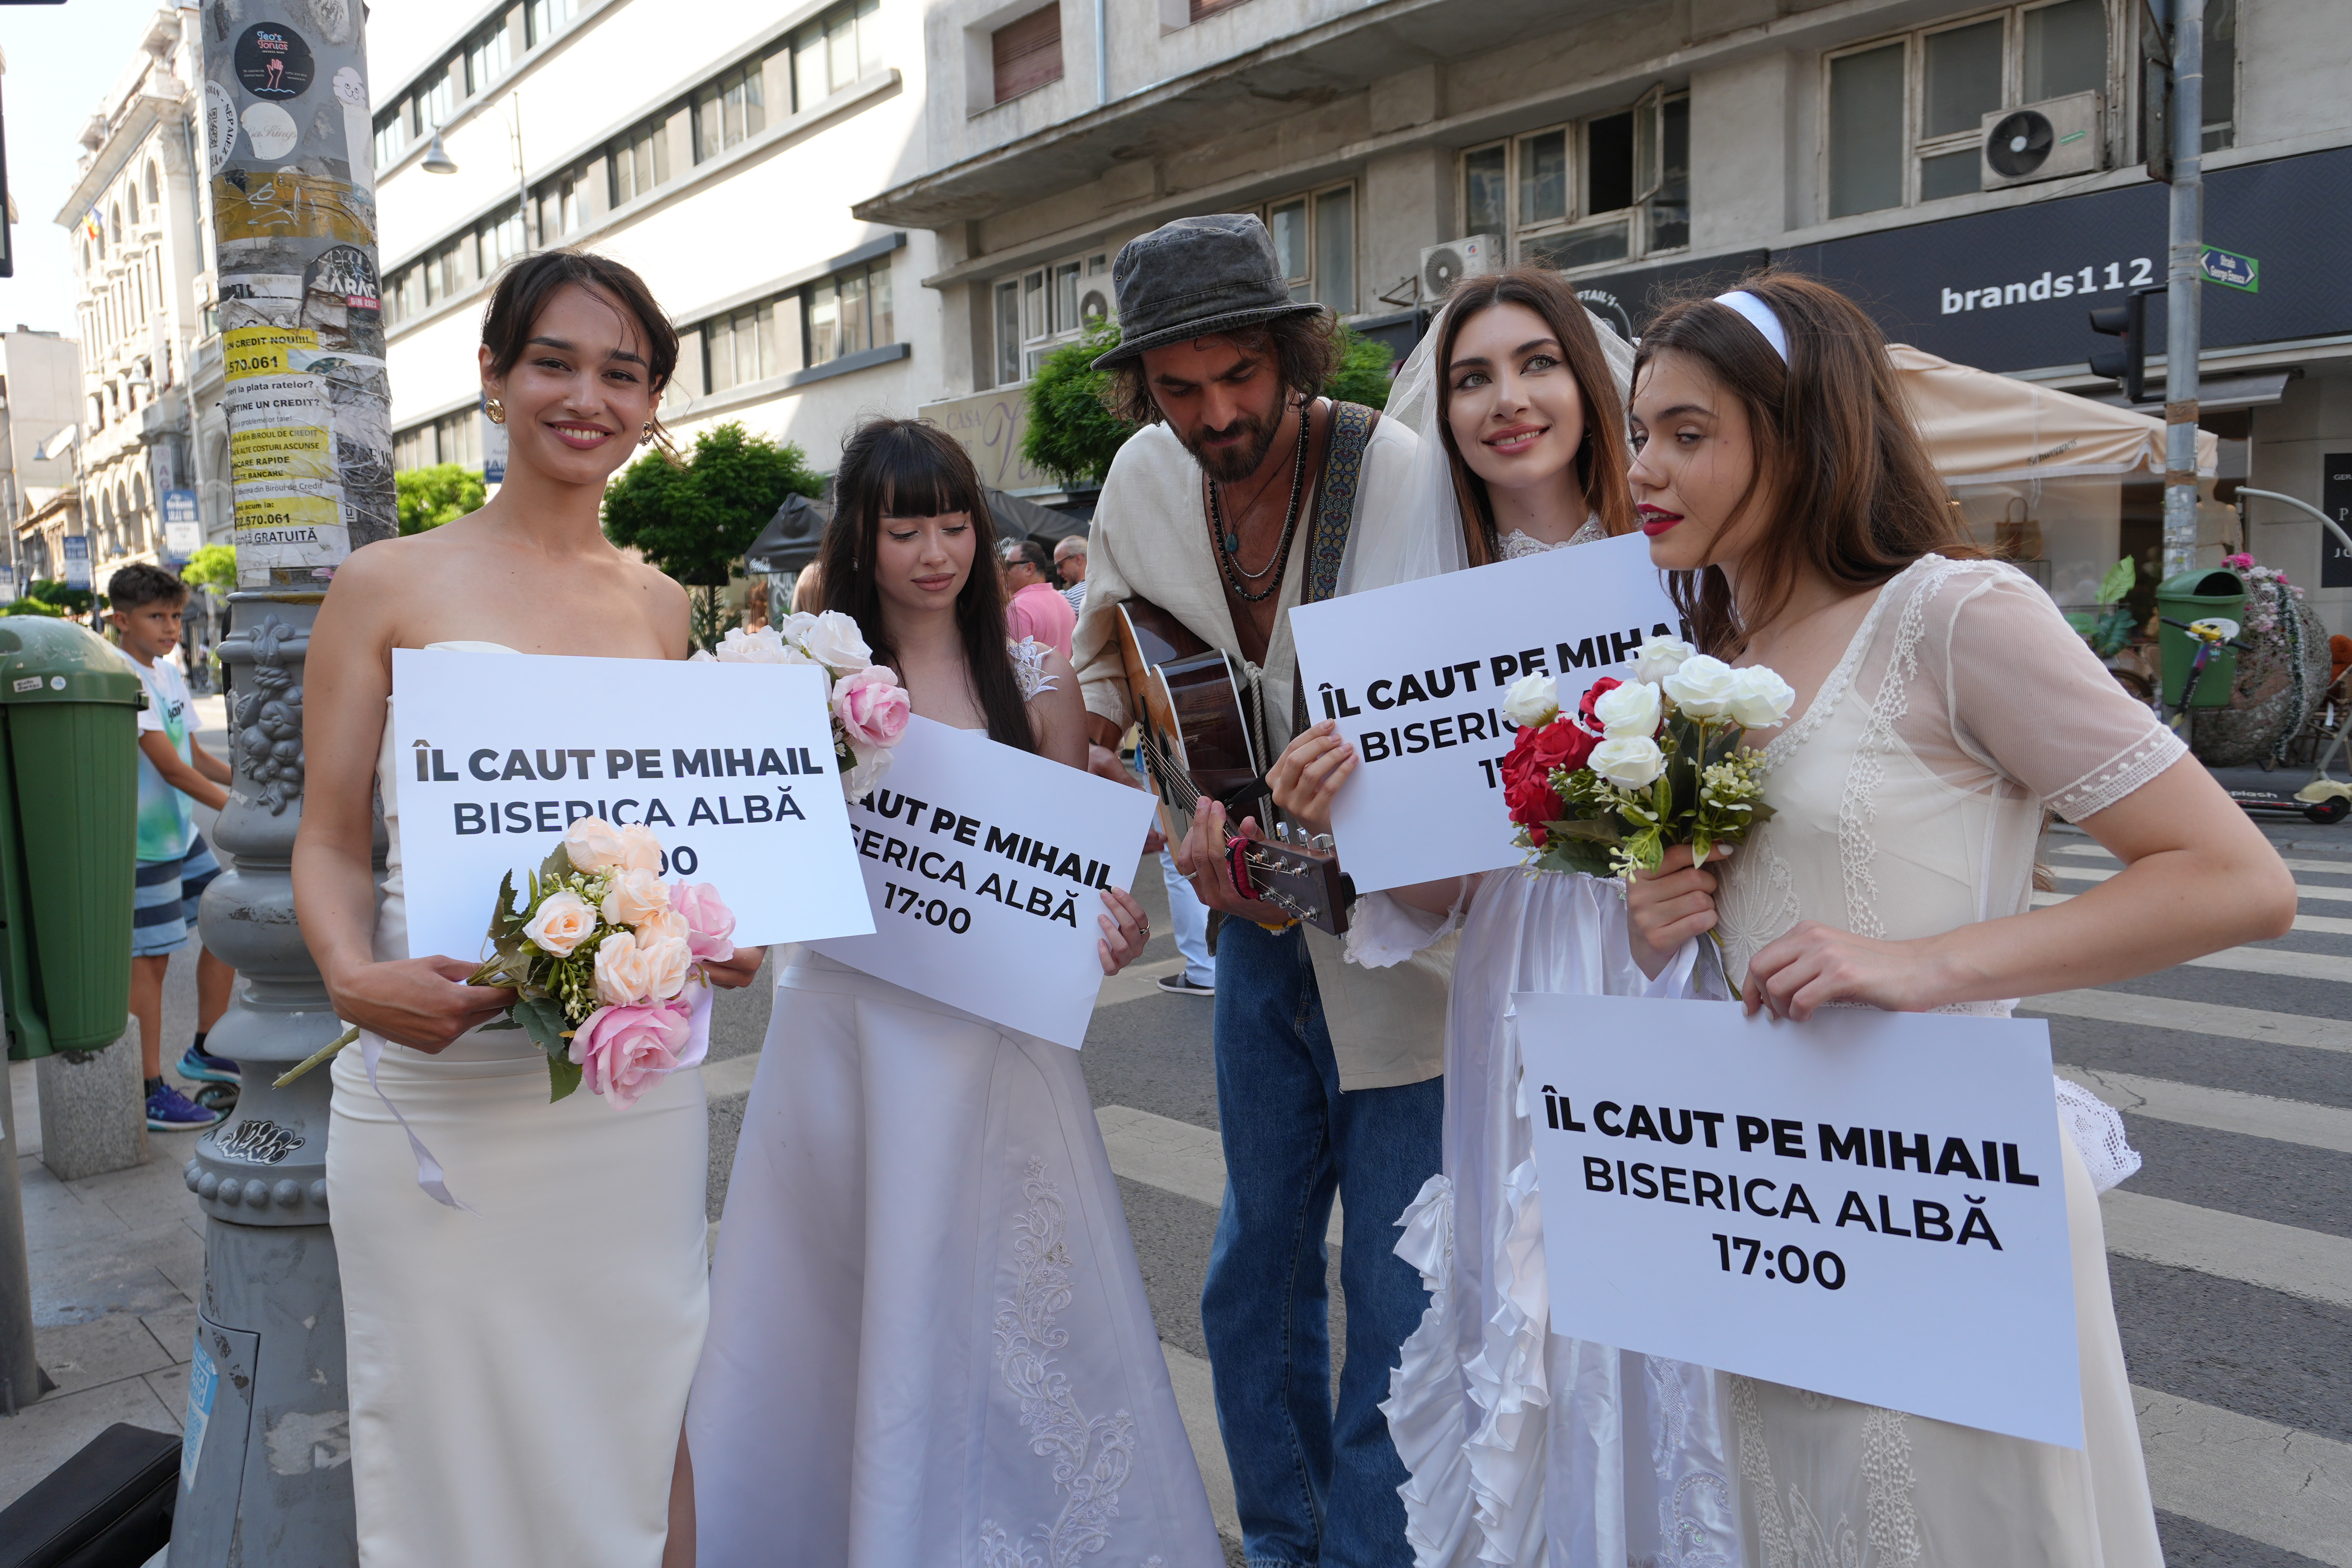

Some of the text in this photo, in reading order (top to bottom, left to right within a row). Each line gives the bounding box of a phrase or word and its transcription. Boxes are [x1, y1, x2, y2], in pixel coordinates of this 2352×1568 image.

[257, 31, 282, 41] Teo's
[258, 40, 288, 51] Tonics
[223, 104, 234, 156] NEPALEZ
[1941, 257, 2153, 315] brands112
[236, 337, 267, 347] CREDIT
[238, 385, 244, 394] la
[247, 383, 269, 393] plata
[272, 381, 313, 389] ratelor?
[273, 399, 320, 407] CREDIT?
[241, 416, 275, 427] problemelor
[946, 409, 981, 431] CASA
[251, 431, 275, 440] BIROUL
[253, 444, 281, 452] COSTURI
[256, 457, 290, 465] RAPIDE
[248, 470, 284, 479] BANCARE
[254, 527, 318, 544] GRATUITĂ
[1317, 683, 1361, 721] ÎL
[1367, 660, 1481, 710] CAUT
[1490, 647, 1550, 686] PE
[411, 739, 824, 782] ÎL CAUT PE MIHAIL
[687, 786, 806, 827] ALBĂ
[847, 788, 1115, 895] AUT PE MIHAIL
[884, 881, 971, 934] 17:00
[975, 872, 1079, 928] ALBĂ
[1541, 1084, 2040, 1187] ÎL CAUT PE MIHAIL
[1582, 1155, 2004, 1251] BISERICA ALBĂ
[1712, 1233, 1846, 1291] 17:00
